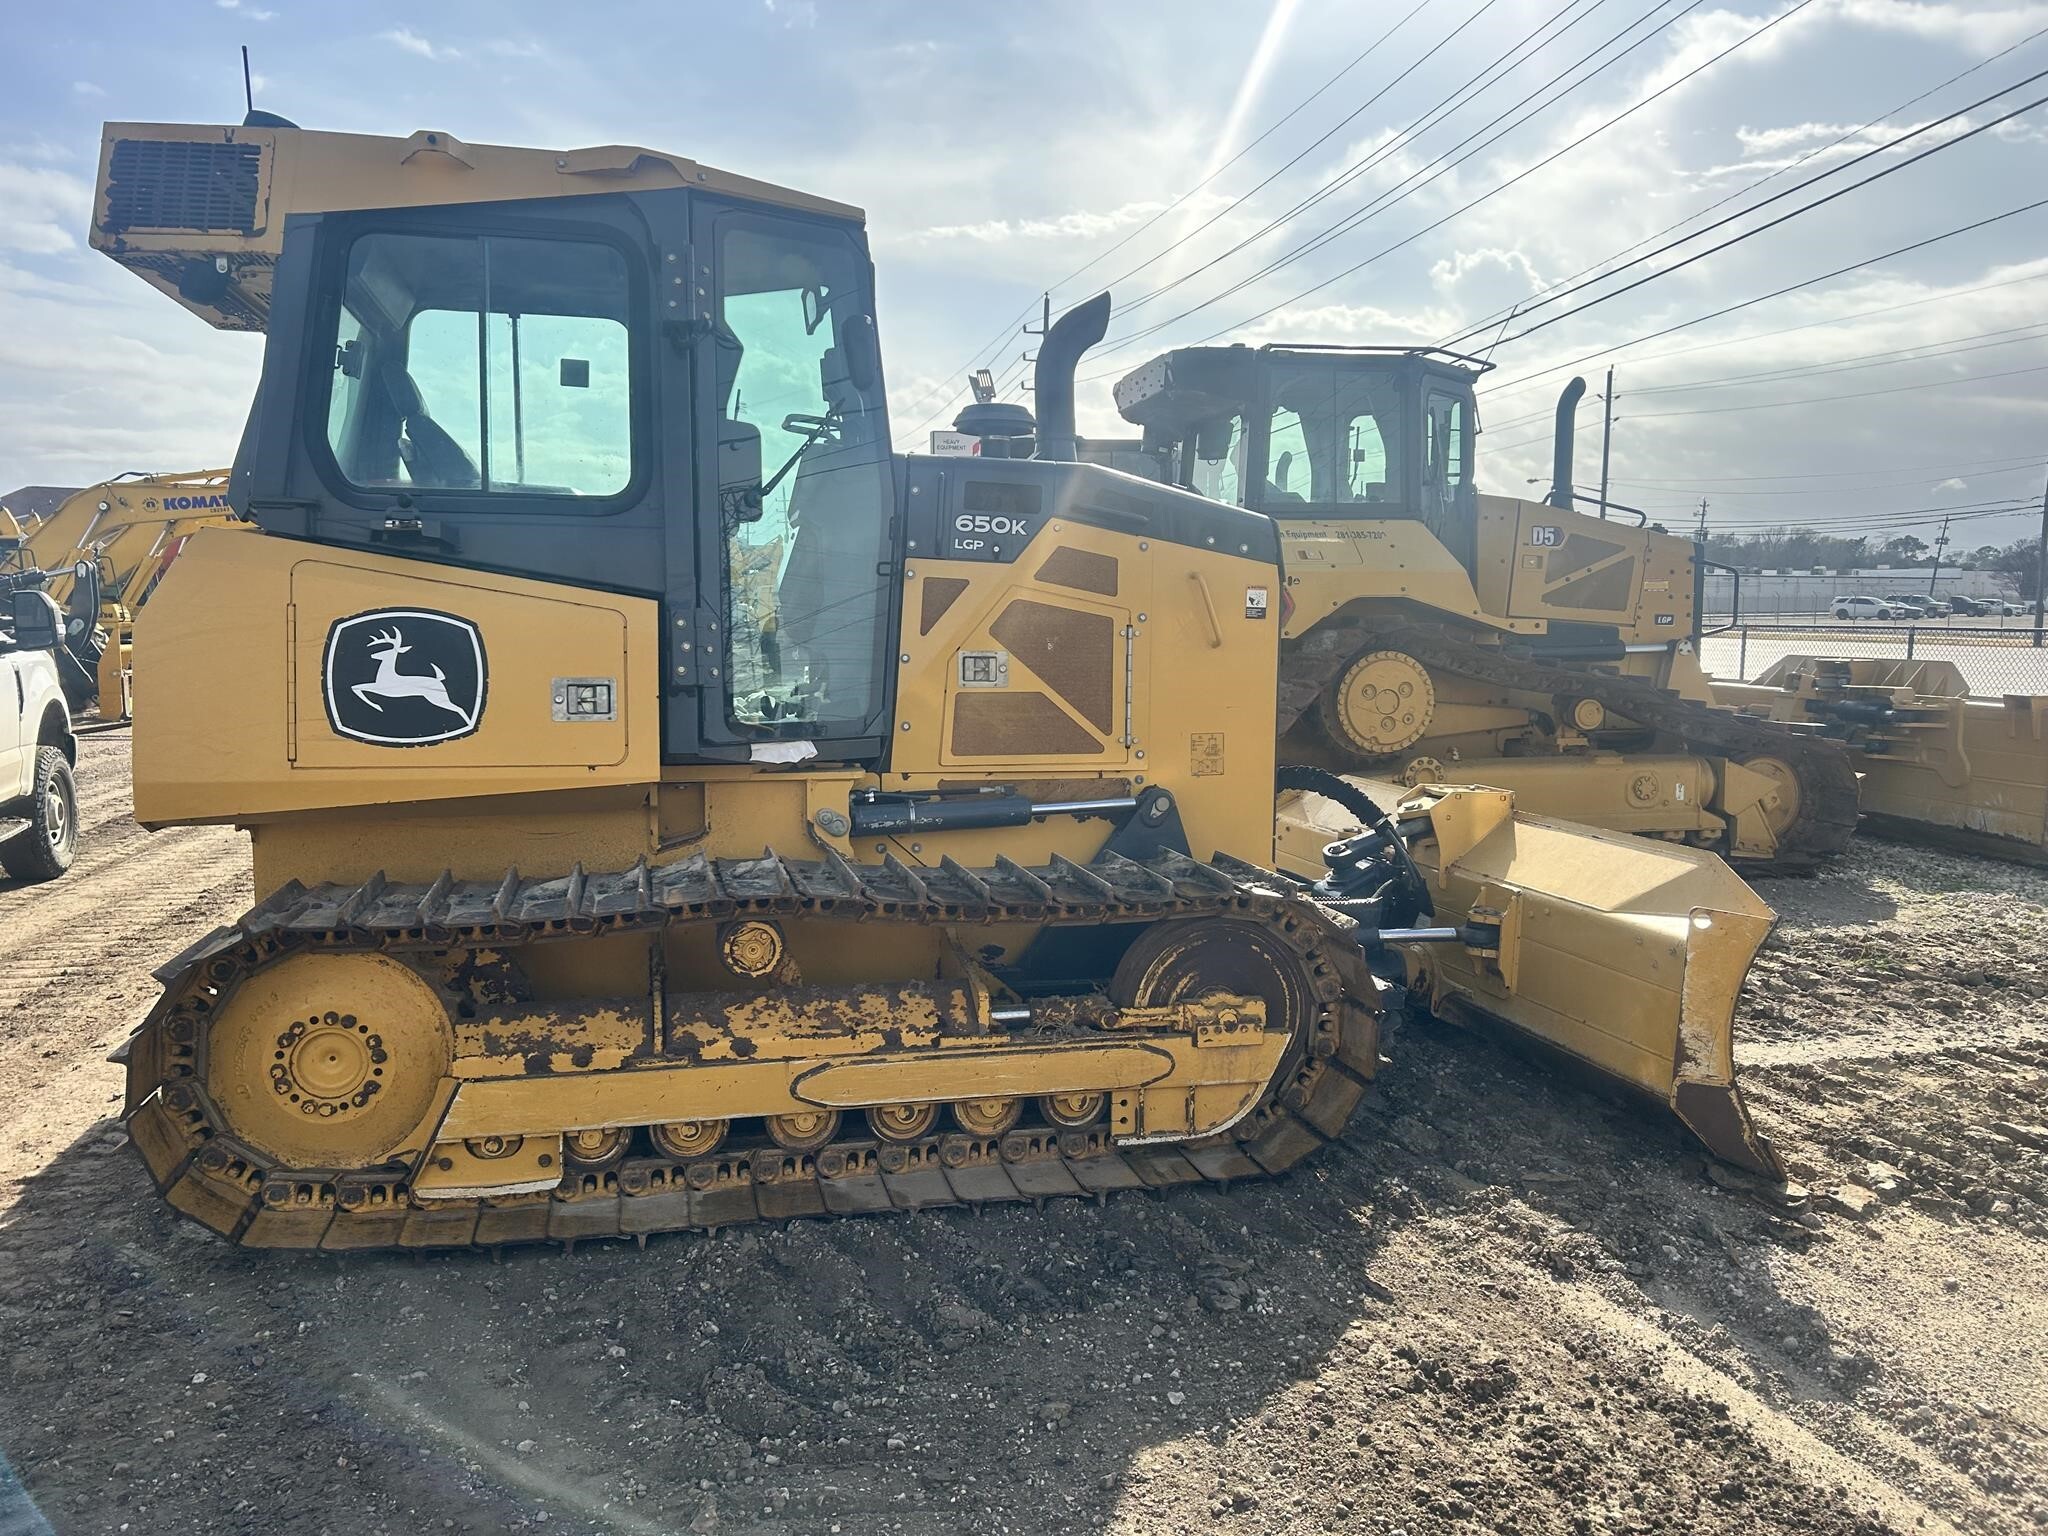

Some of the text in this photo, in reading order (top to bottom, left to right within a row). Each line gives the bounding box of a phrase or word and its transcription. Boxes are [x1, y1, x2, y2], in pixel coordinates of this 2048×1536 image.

[955, 514, 1028, 536] 650K
[1286, 530, 1328, 540] Equipment
[1532, 526, 1555, 546] D5
[954, 538, 985, 551] LGP
[1657, 616, 1673, 624] LGP
